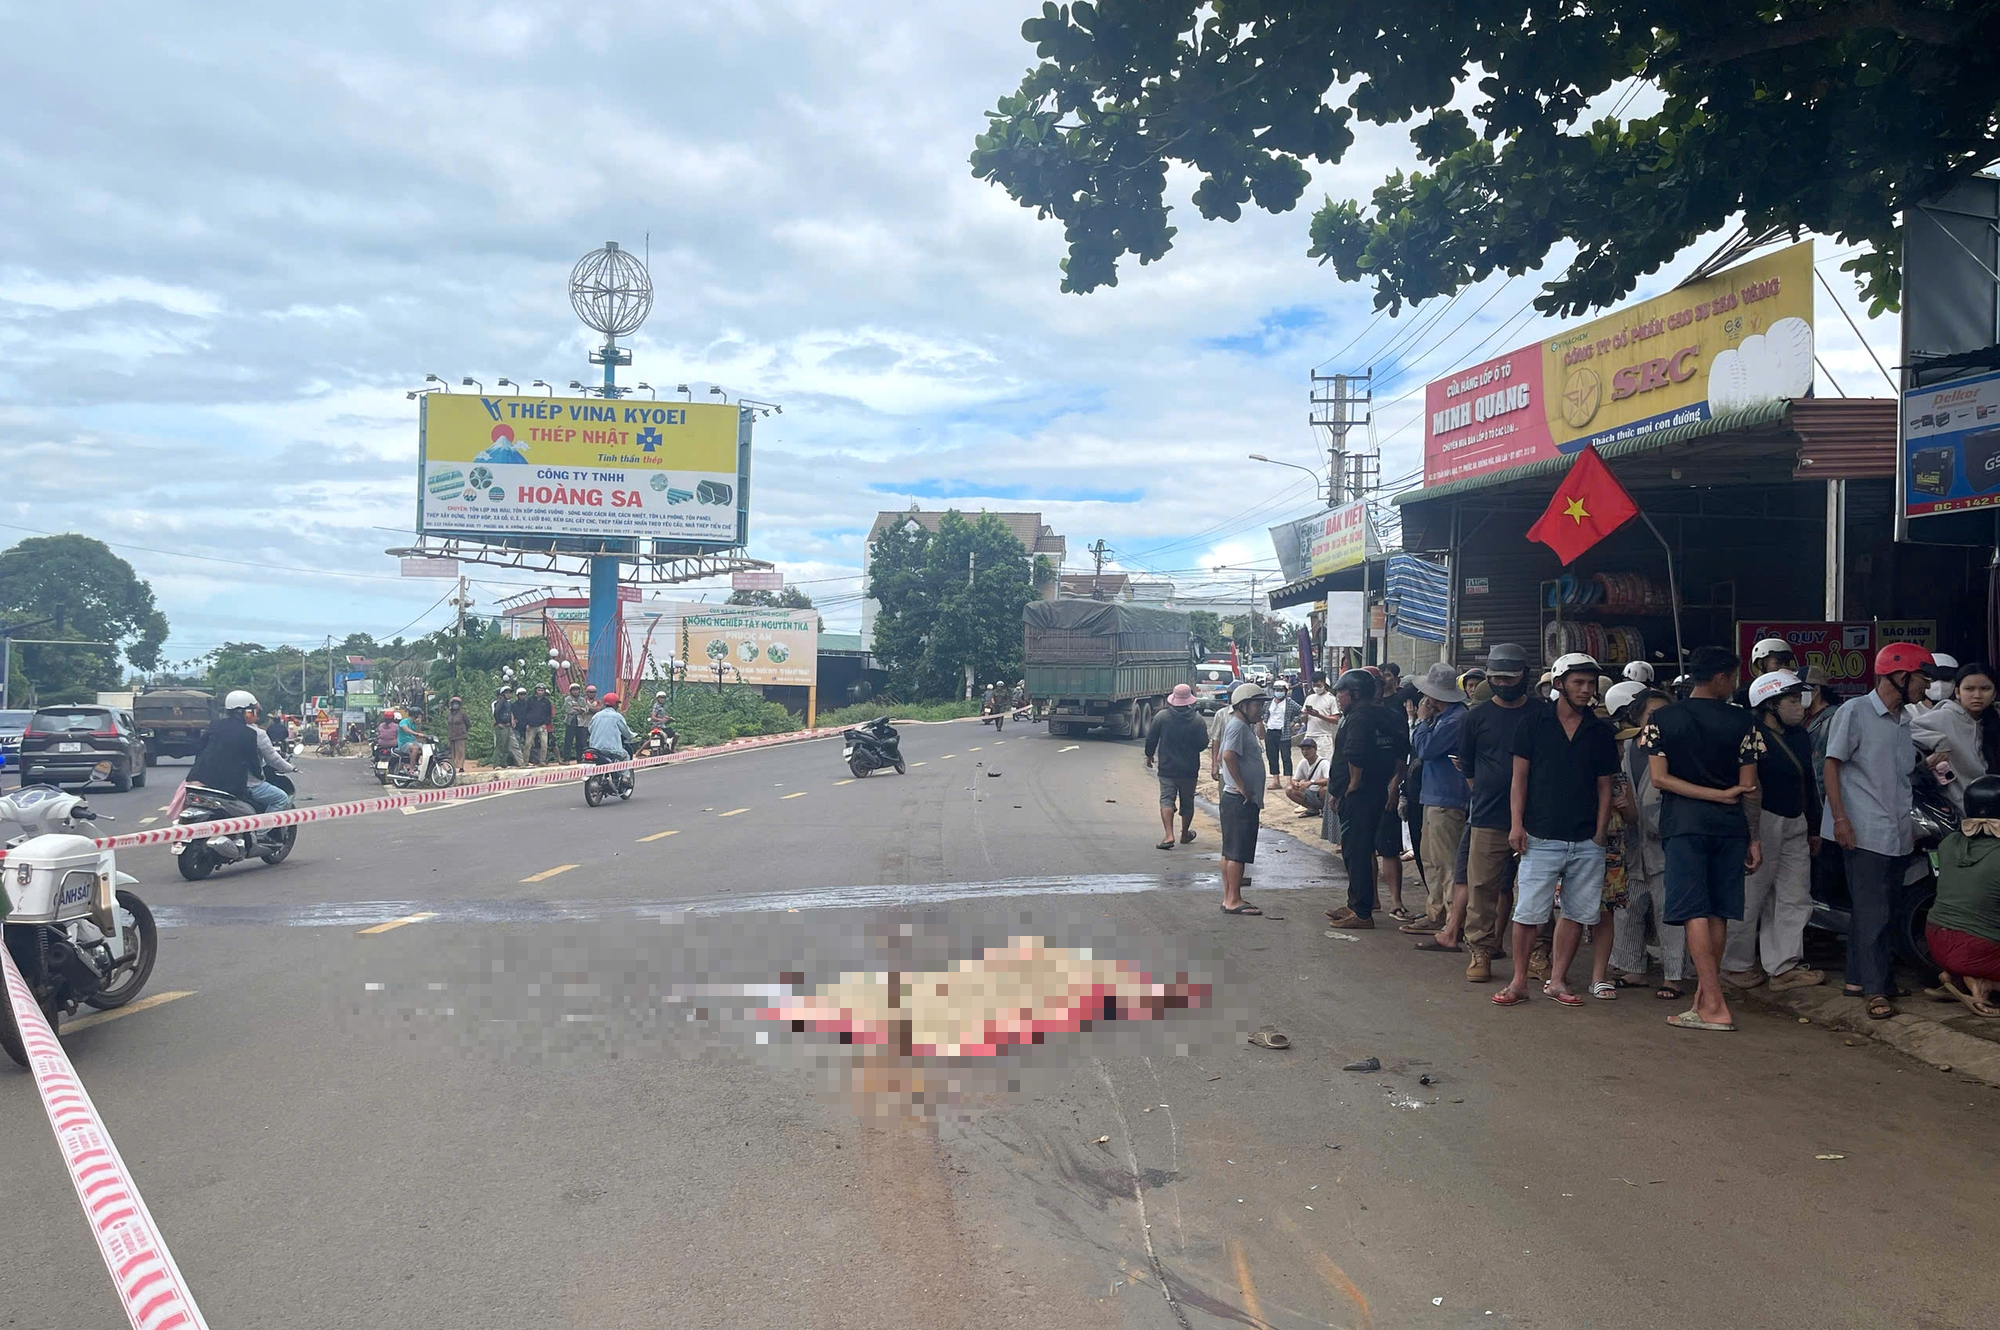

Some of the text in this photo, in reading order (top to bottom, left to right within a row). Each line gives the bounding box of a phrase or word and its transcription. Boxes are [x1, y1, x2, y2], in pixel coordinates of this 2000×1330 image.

[1564, 346, 1594, 366] CÔNG
[1667, 308, 1693, 330] CAO
[1712, 293, 1738, 315] SAO
[1611, 345, 1700, 401] SRC
[1933, 388, 1981, 405] Delkor
[507, 400, 686, 425] THÉP VINA KYOEI
[1432, 383, 1530, 436] MINH QUANG
[529, 425, 629, 448] THÉP NHẬT
[1592, 407, 1701, 447] Thách thức mọi con đường
[642, 455, 663, 465] thép
[537, 468, 624, 482] CÔNG TY TNHH
[518, 483, 643, 508] HOÀNG SA
[1965, 498, 1989, 508] 142
[687, 615, 808, 631] NÔNG NGHIỆP TÂY NGUYÊN TKA
[1786, 630, 1828, 645] QUY
[1806, 641, 1866, 679] BẢO
[77, 881, 90, 901] SÁT
